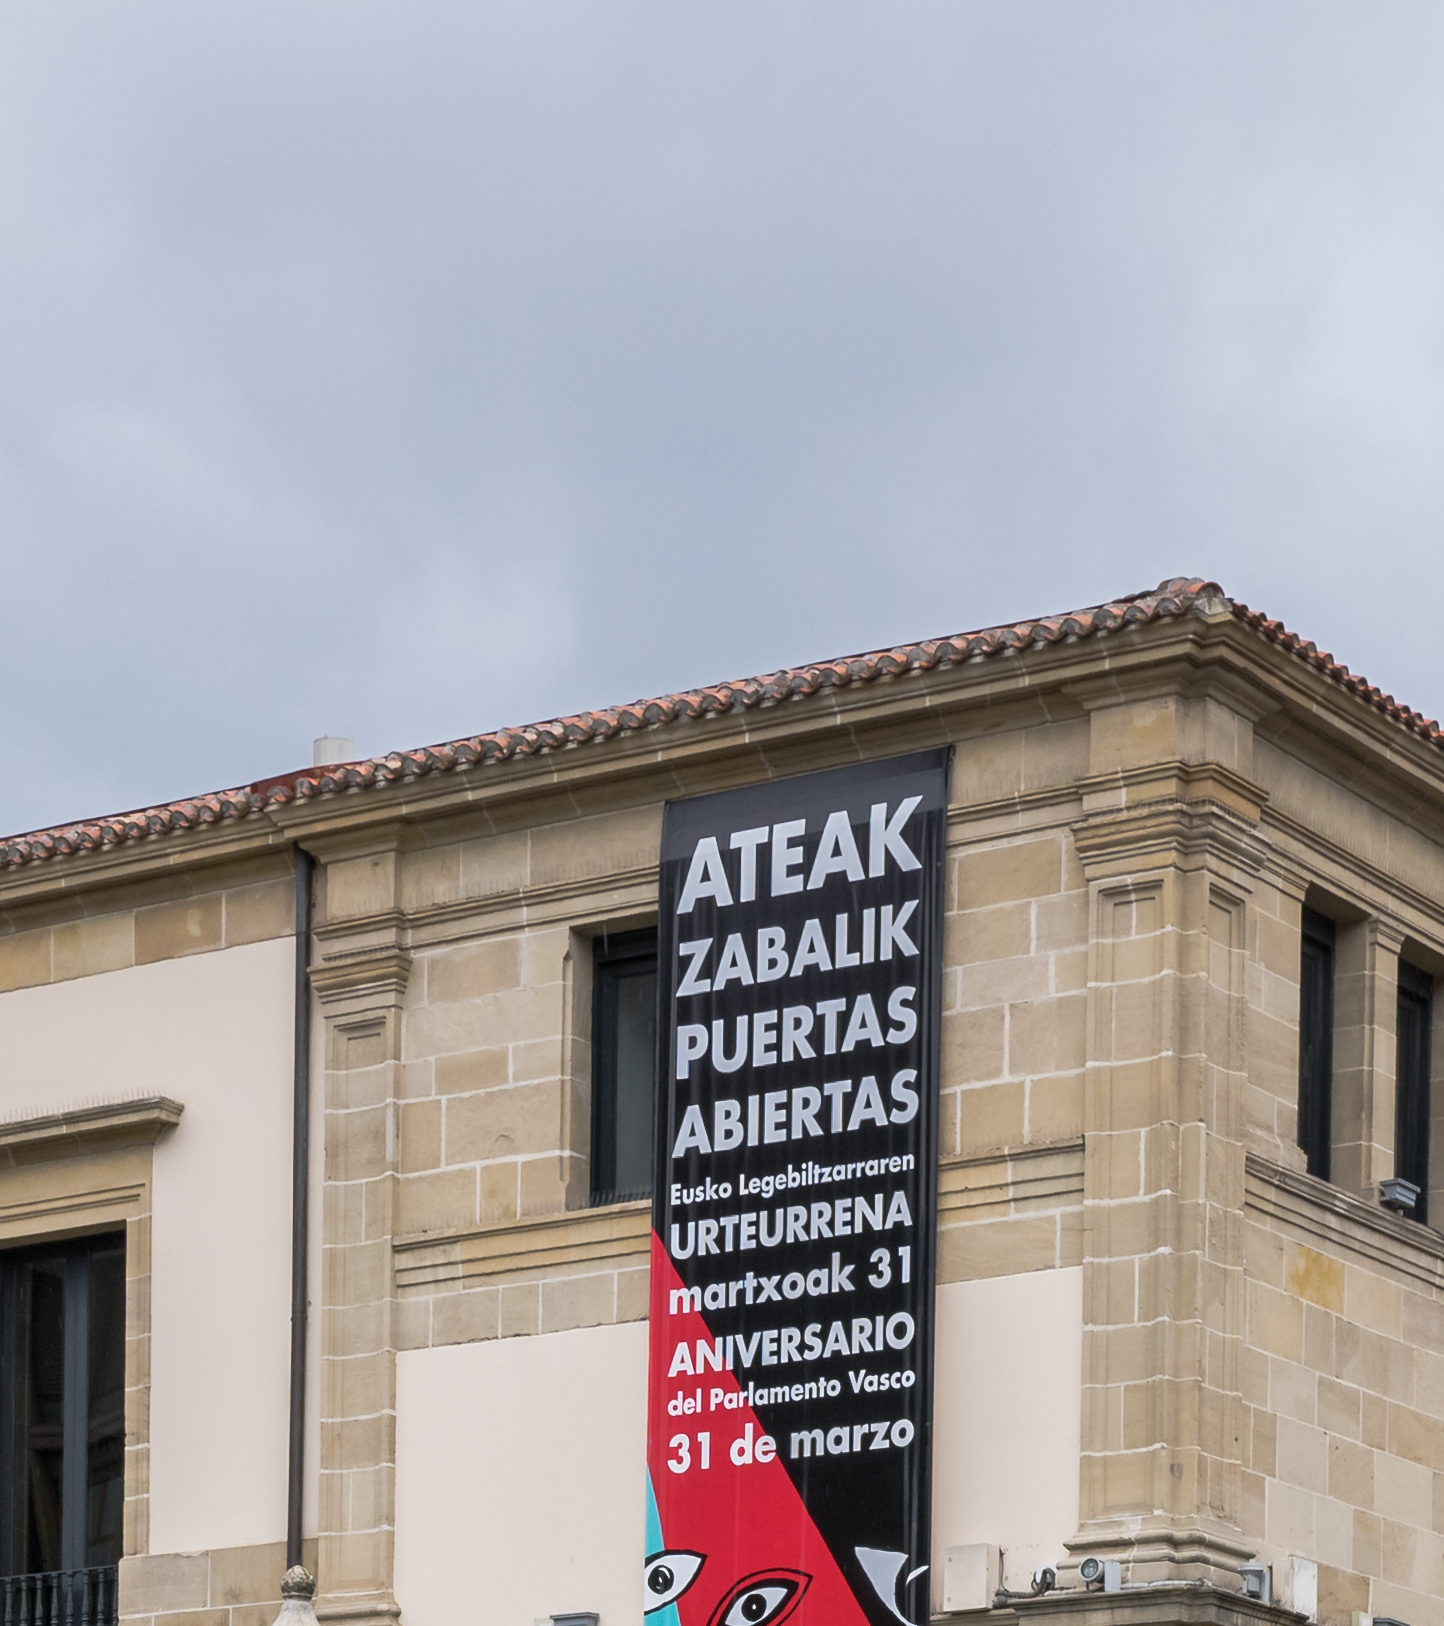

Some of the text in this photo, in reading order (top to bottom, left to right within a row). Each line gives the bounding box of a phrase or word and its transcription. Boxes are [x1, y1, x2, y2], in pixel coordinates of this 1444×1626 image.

[676, 795, 924, 915] ATEAK
[675, 899, 920, 998] ZABALIK
[676, 985, 918, 1080] PUERTAS
[671, 1068, 920, 1159] ABIERTAS
[669, 1153, 915, 1206] Eusko Legebiltzarraren
[670, 1189, 913, 1260] URTEURRENA
[669, 1245, 911, 1315] martxoak 31
[667, 1311, 916, 1378] ANIVERSARIO
[667, 1368, 916, 1417] del Parlamento Vasco
[666, 1418, 915, 1475] 31 de marzo
